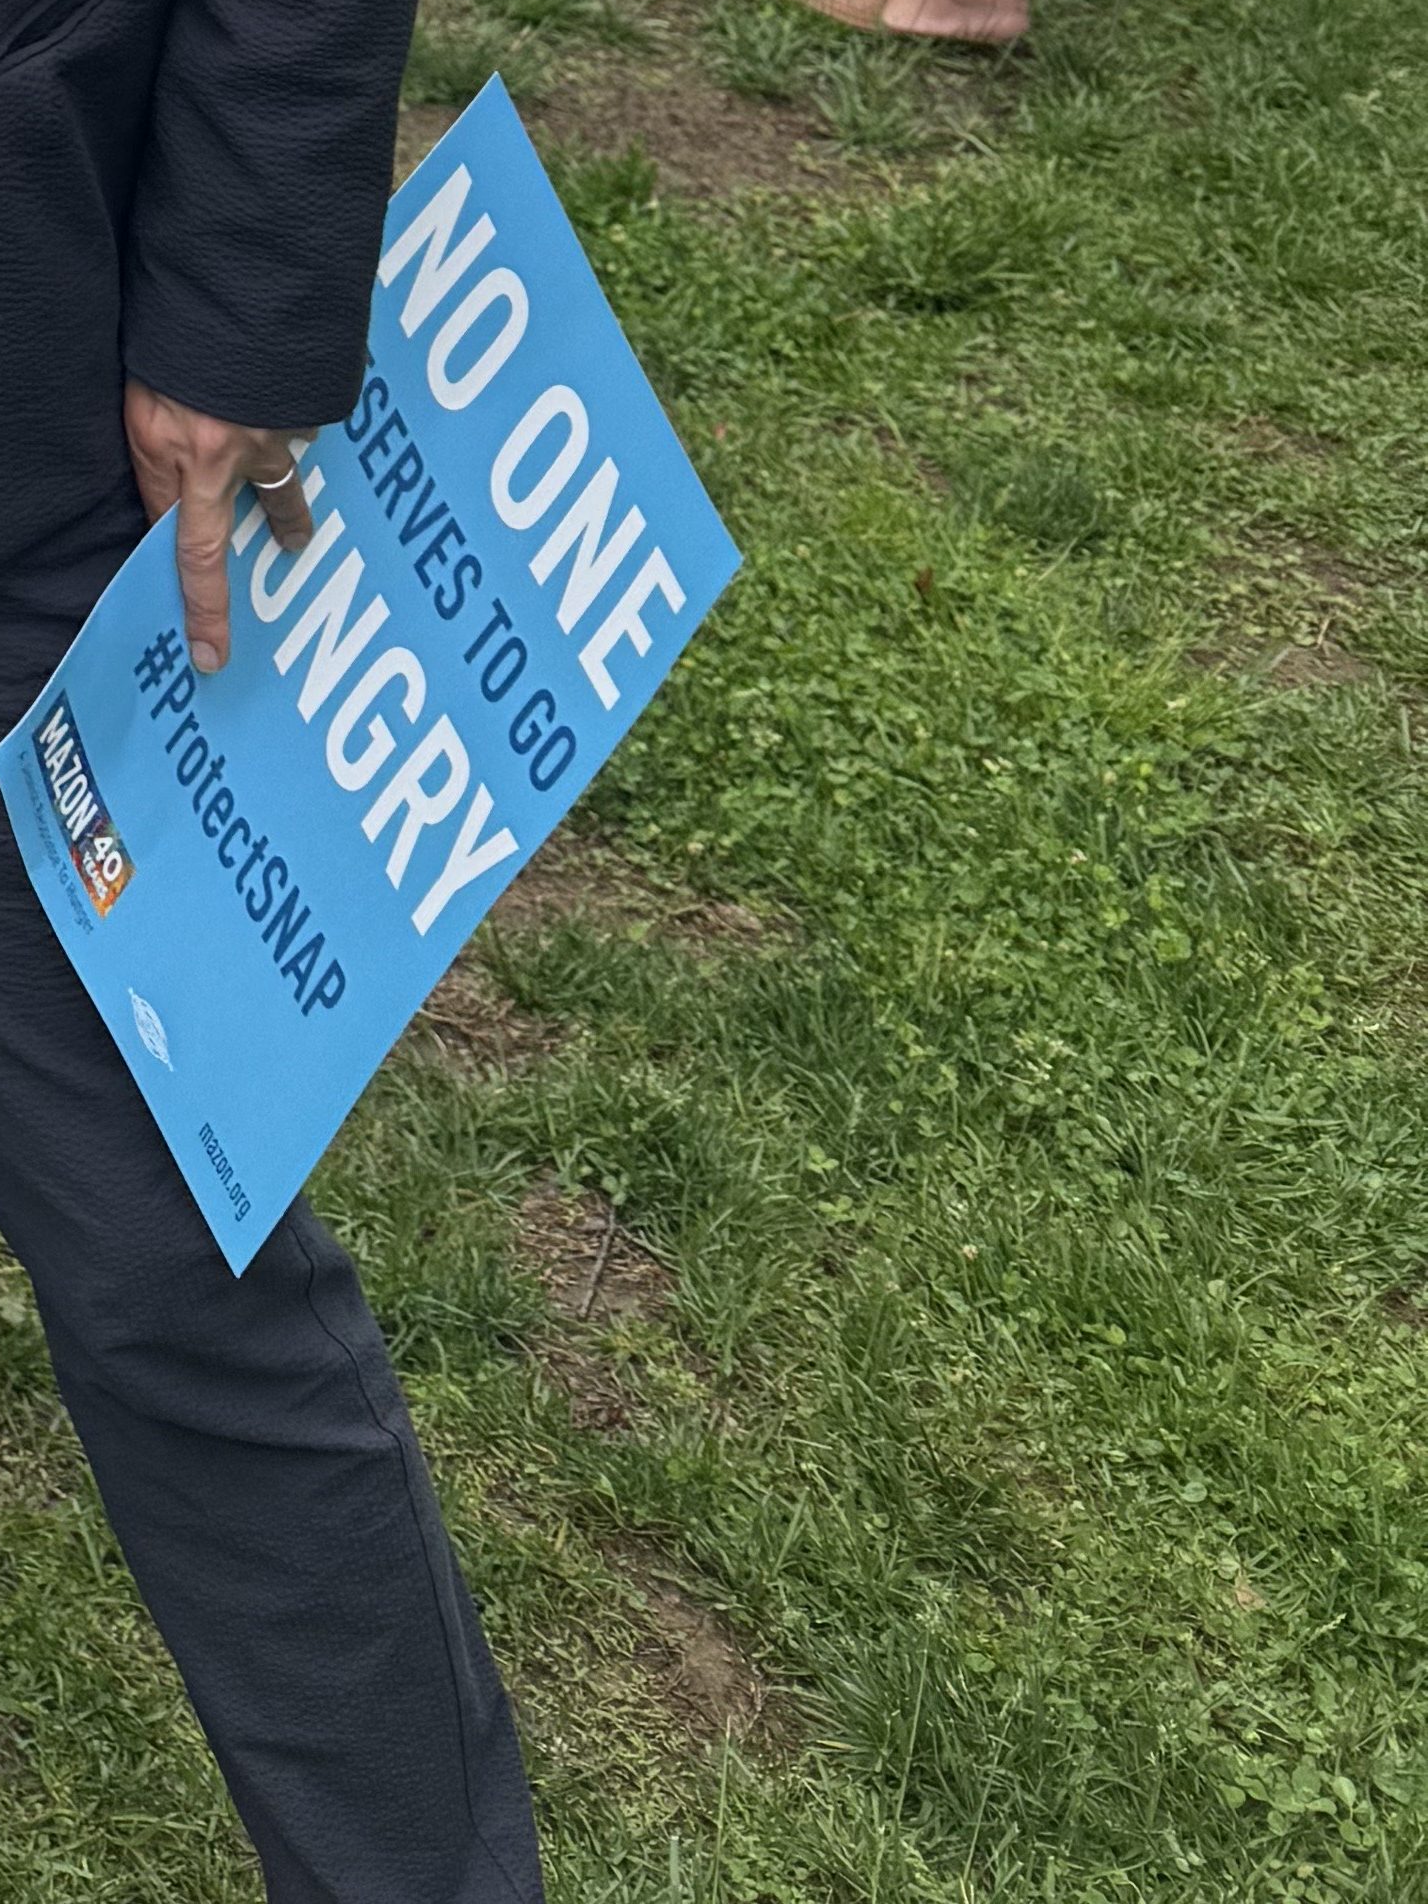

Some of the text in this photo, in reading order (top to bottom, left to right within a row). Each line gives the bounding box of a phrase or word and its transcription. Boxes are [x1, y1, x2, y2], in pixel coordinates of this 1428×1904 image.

[345, 349, 577, 792] SERVES TO GO
[378, 162, 687, 710] NO ONE
[40, 706, 123, 881] MAZON 40
[83, 851, 108, 900] YEARS
[134, 627, 346, 1016] #ProtectSNAP
[198, 1122, 251, 1222] mazon.org
